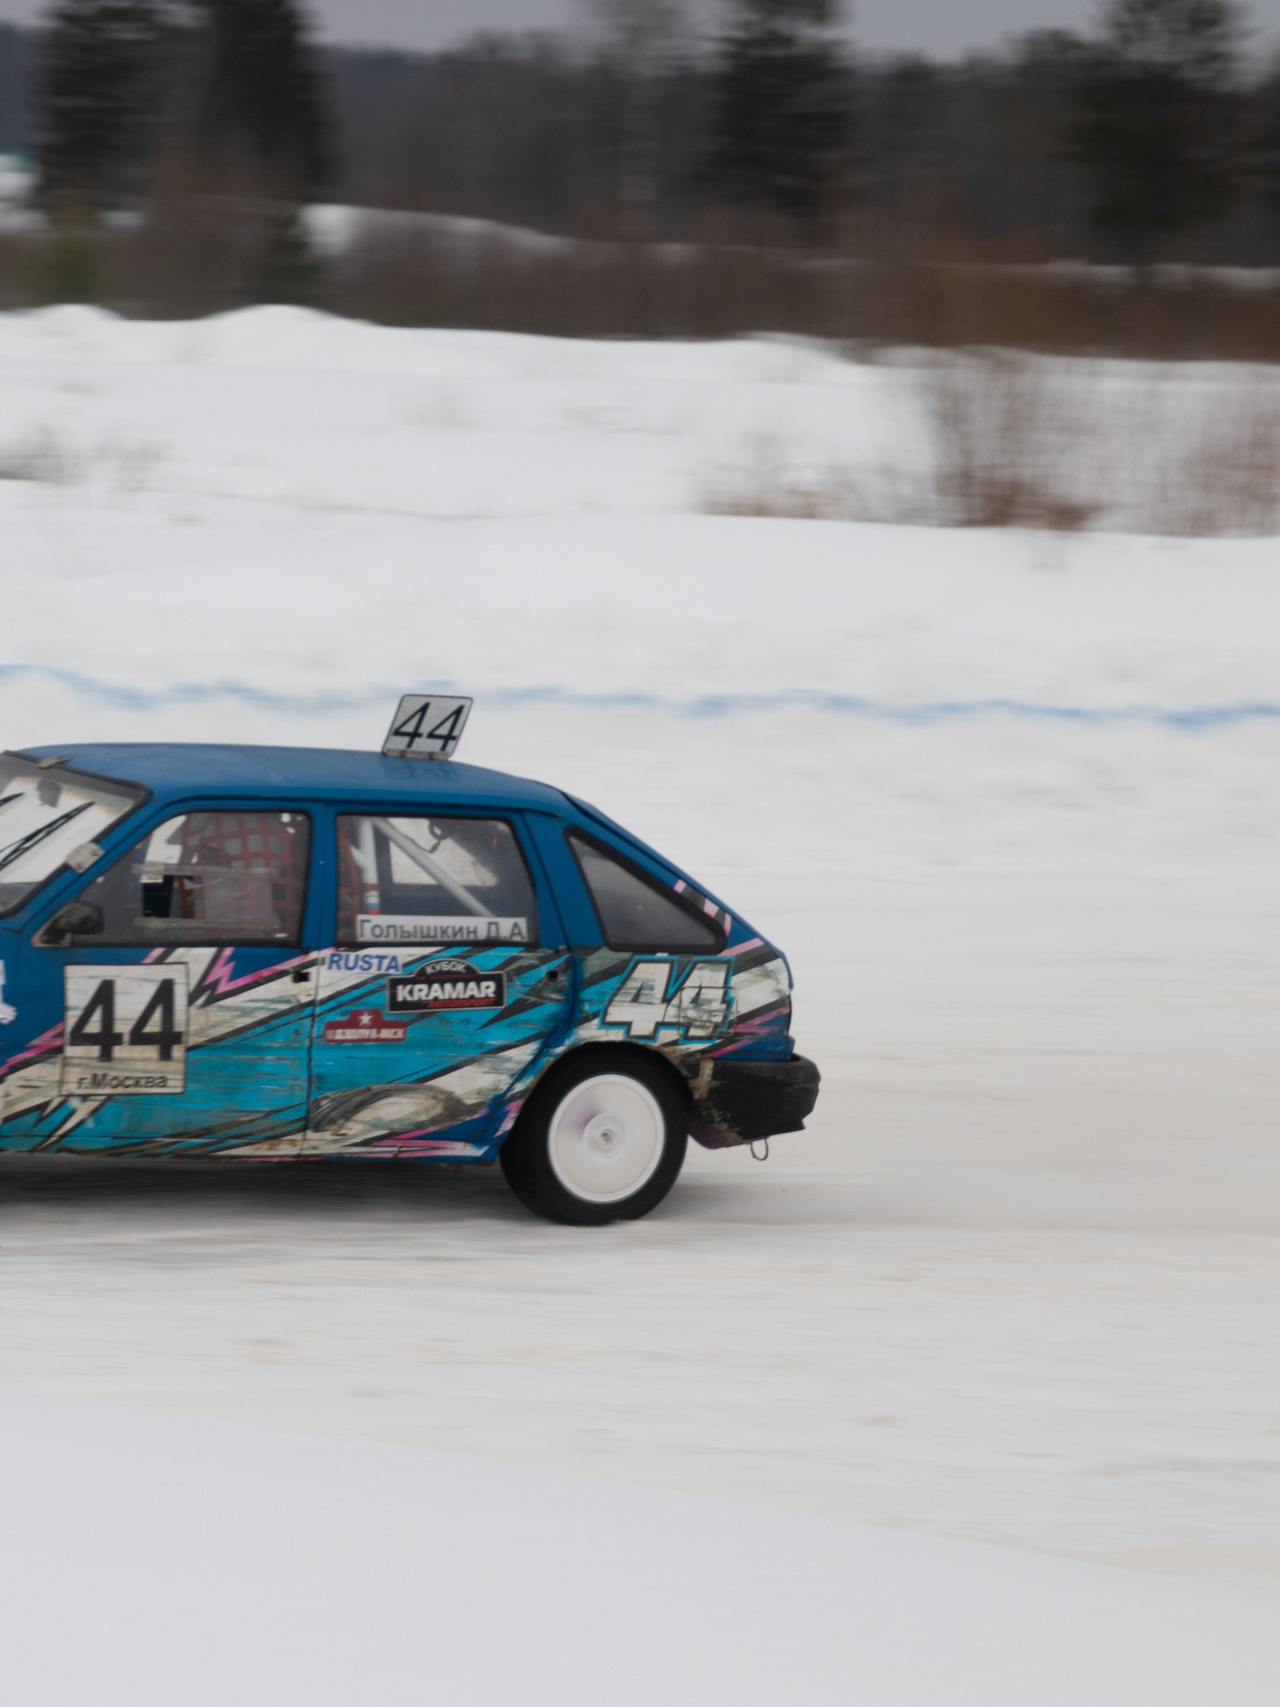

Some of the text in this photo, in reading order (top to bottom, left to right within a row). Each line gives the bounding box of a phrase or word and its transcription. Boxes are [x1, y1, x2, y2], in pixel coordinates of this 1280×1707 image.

[391, 701, 466, 752] 44
[358, 919, 478, 941] Голышкин
[328, 953, 400, 972] RUSTA
[425, 961, 467, 975] КУБОК
[396, 980, 497, 1002] KRAMAR
[598, 955, 736, 1044] 44
[69, 978, 183, 1062] 44
[76, 1072, 168, 1090] г.Москва
